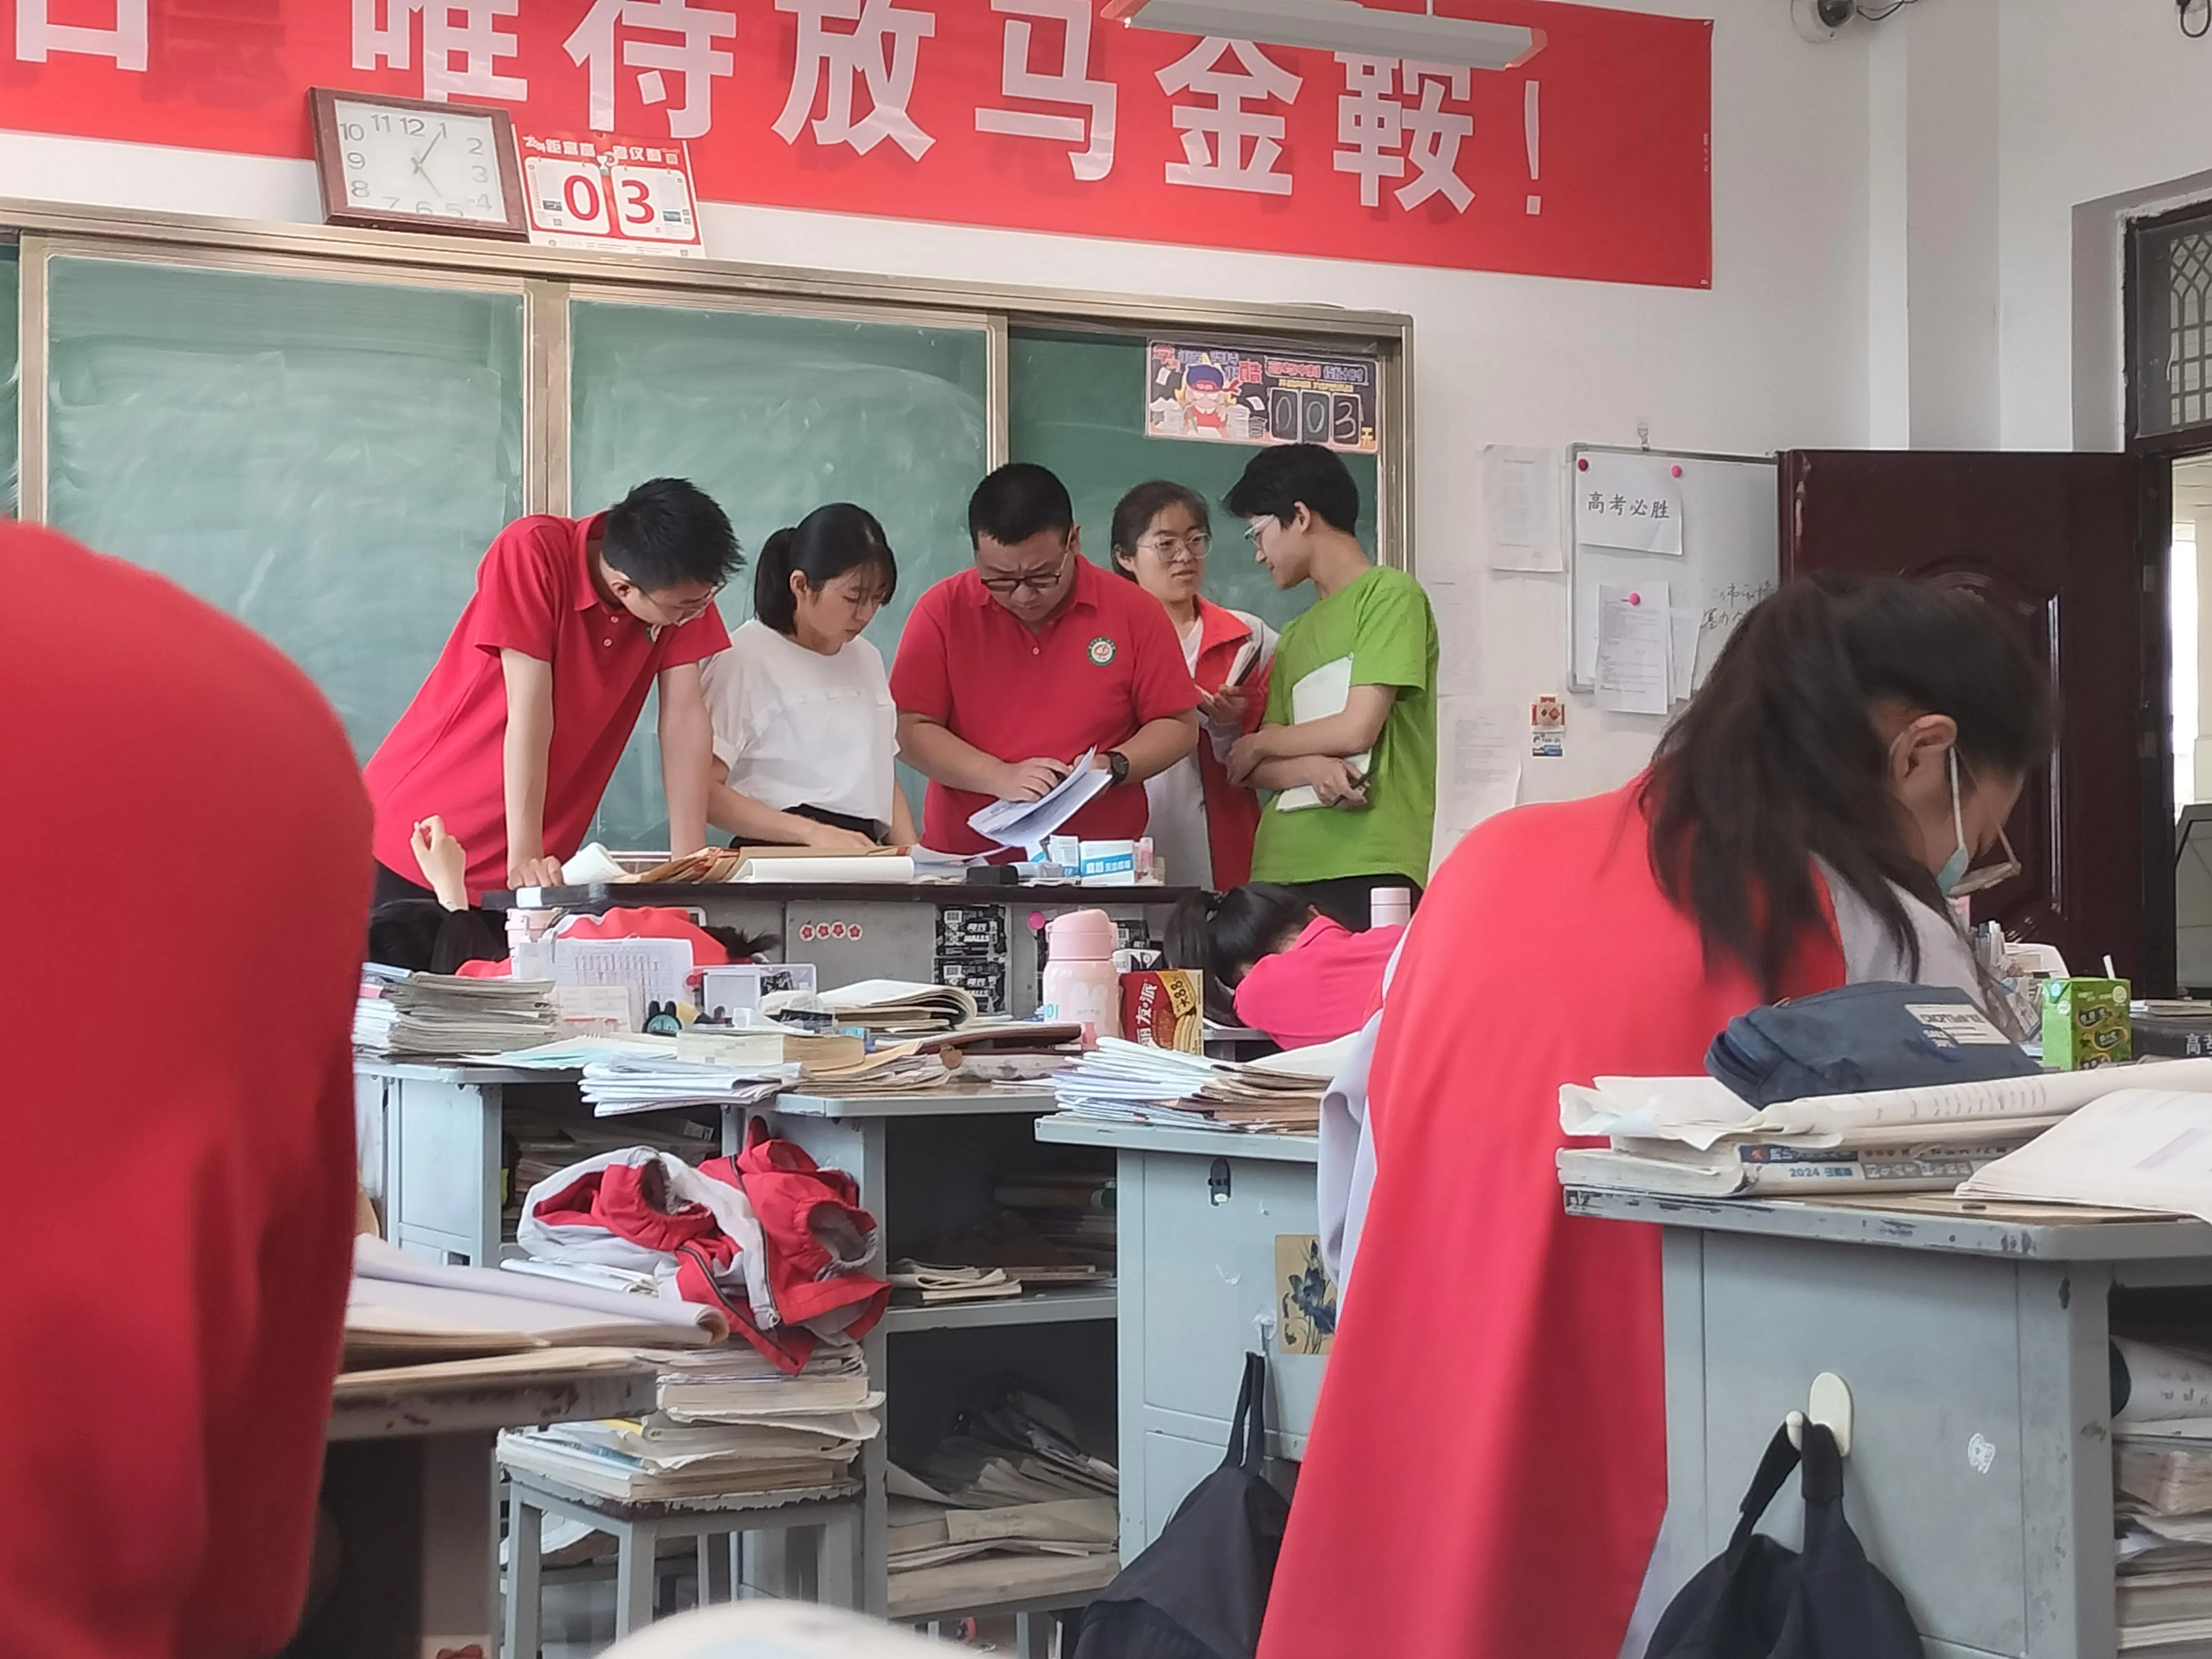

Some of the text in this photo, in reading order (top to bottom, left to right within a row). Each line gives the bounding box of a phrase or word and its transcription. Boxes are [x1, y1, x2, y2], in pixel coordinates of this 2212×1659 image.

[340, 123, 365, 141] 10
[371, 114, 391, 133] 11
[399, 117, 425, 137] 12
[439, 122, 447, 140] 1
[467, 137, 483, 155] 2
[347, 152, 366, 170] 9
[471, 165, 488, 183] 3
[351, 180, 370, 198] 8
[383, 196, 399, 210] 7
[446, 203, 464, 217] 5
[474, 193, 492, 211] 4
[1588, 491, 1670, 519] 高考必胜
[1789, 1167, 1820, 1177] 2024
